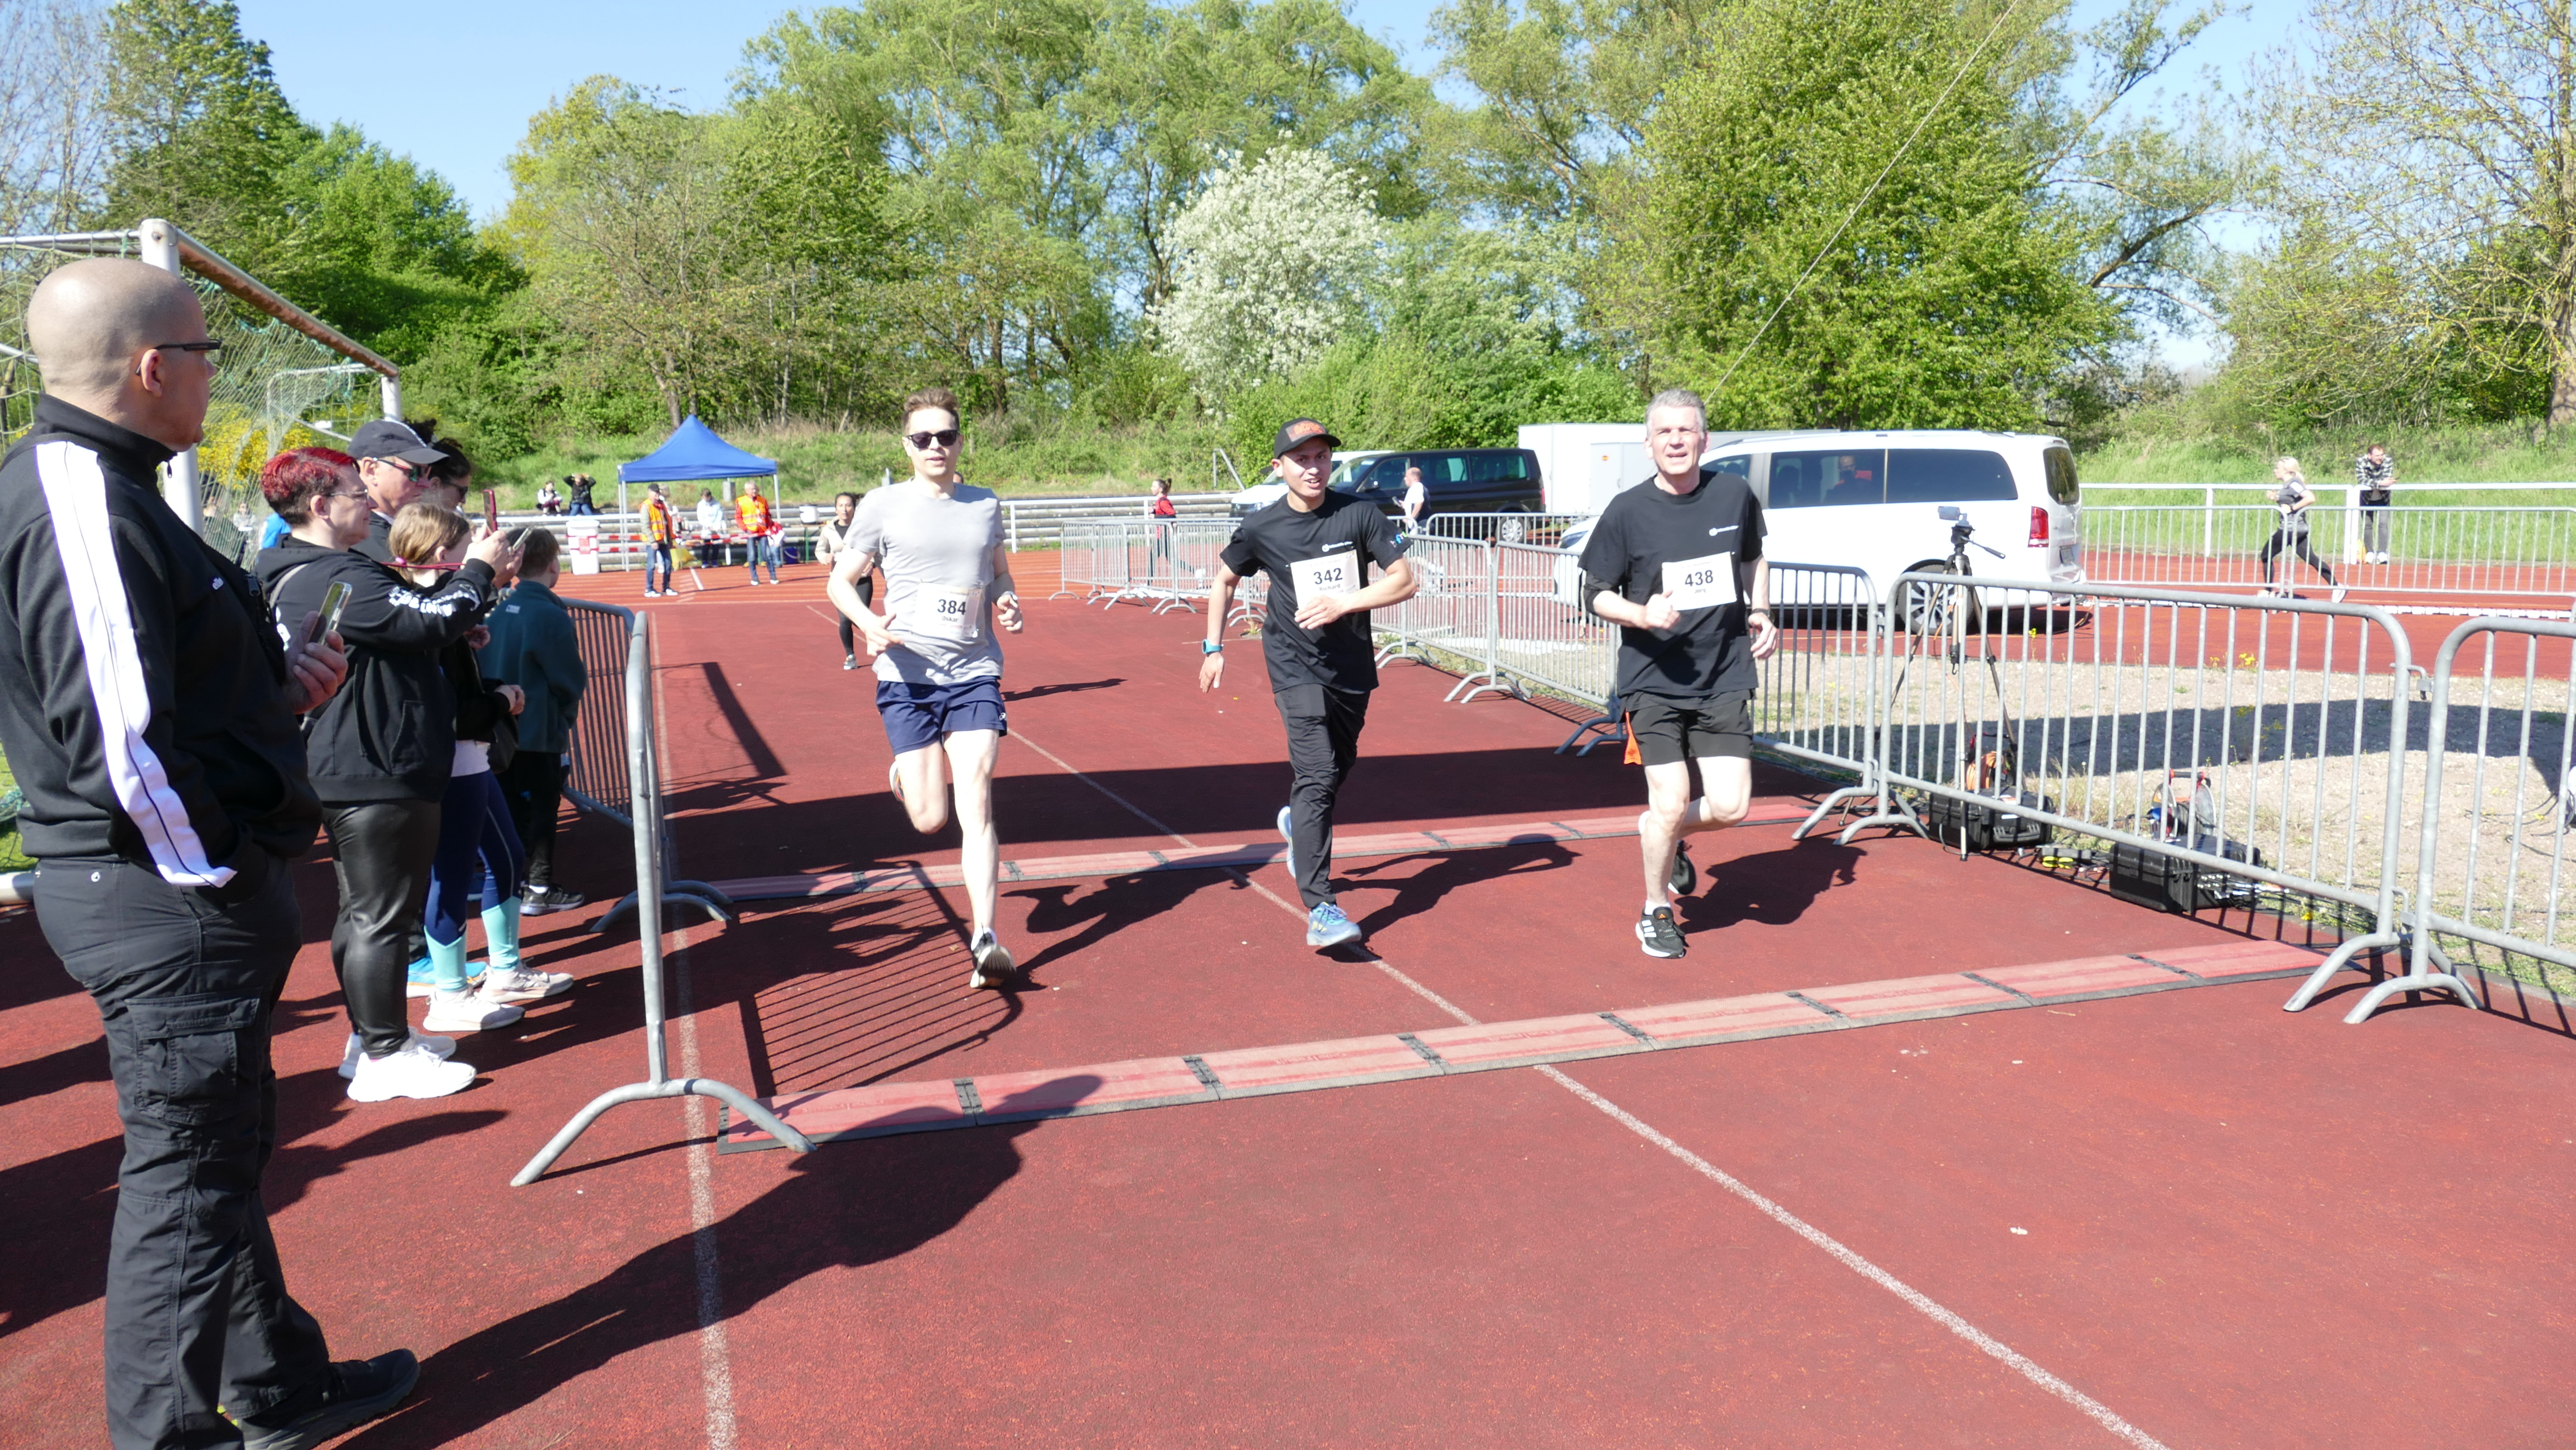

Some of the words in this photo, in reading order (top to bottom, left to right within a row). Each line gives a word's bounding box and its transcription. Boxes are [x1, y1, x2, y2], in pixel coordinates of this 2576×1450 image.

[1313, 568, 1343, 584] 342
[1685, 570, 1714, 587] 438
[937, 599, 966, 615] 384
